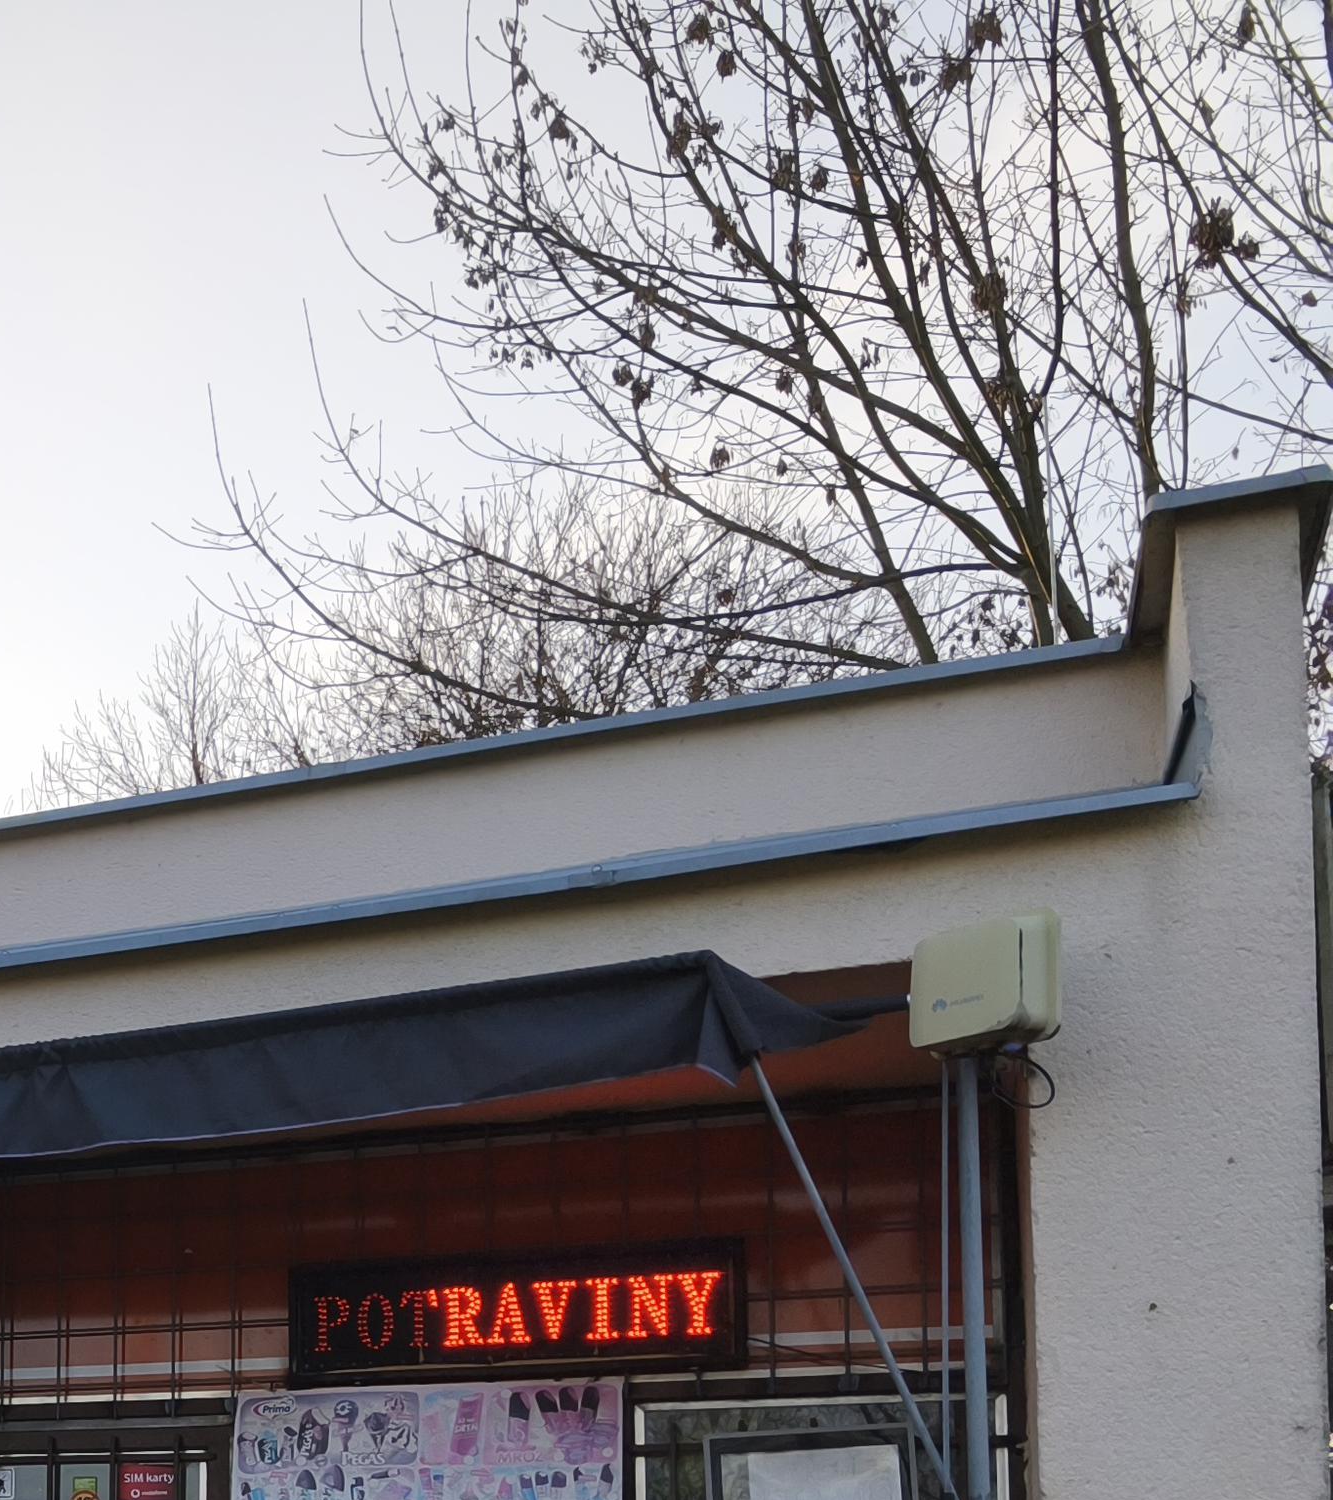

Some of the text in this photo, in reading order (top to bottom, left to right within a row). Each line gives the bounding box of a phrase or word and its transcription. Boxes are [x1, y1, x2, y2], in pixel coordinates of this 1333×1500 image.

[313, 1270, 724, 1352] POTRAVINY
[262, 1403, 291, 1414] Prima
[124, 1472, 174, 1484] SIM karty
